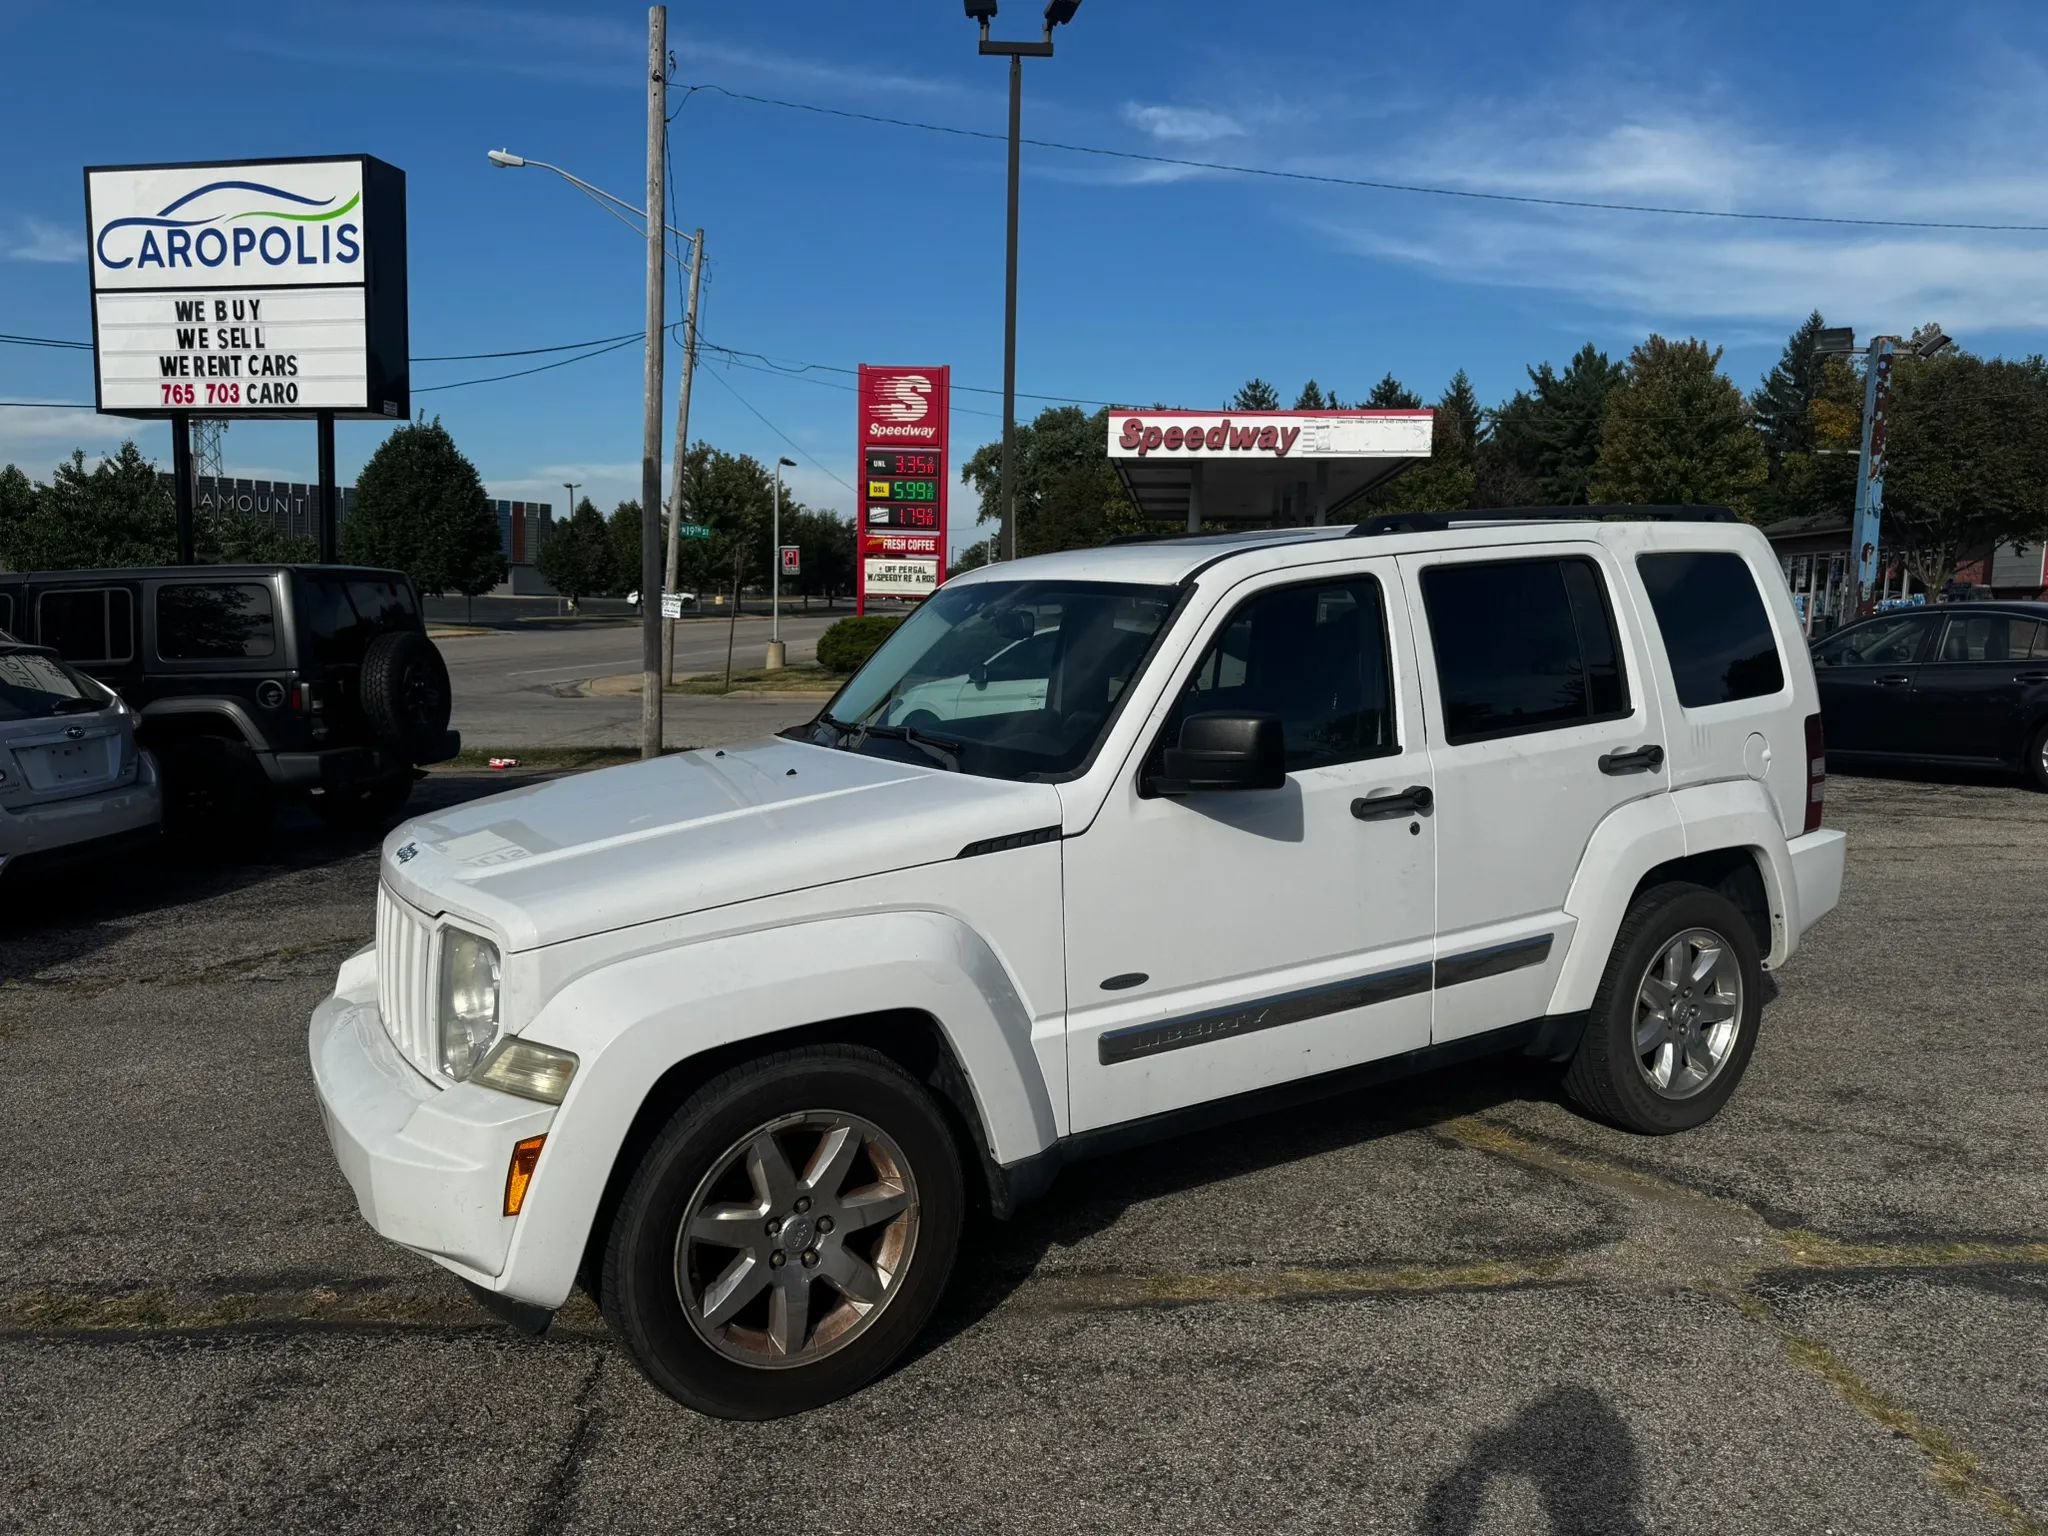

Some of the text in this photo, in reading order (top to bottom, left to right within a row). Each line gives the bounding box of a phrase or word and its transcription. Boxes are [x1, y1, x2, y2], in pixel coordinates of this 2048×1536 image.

[97, 217, 360, 270] CAROPOLIS
[175, 299, 261, 322] WE BUY
[176, 327, 265, 350] WE SELL
[248, 355, 298, 376] CARS
[161, 382, 298, 404] 765 703 CARO
[869, 422, 937, 439] Speedway
[1119, 418, 1301, 457] Speedway
[873, 460, 887, 468] UNL
[895, 455, 926, 473] 3.35
[894, 481, 926, 500] 5.99
[900, 508, 925, 525] 1.79
[882, 538, 907, 551] FRESH
[907, 539, 936, 552] COFFEE
[885, 565, 897, 573] OFF
[1131, 1008, 1270, 1051] LIBERTY
